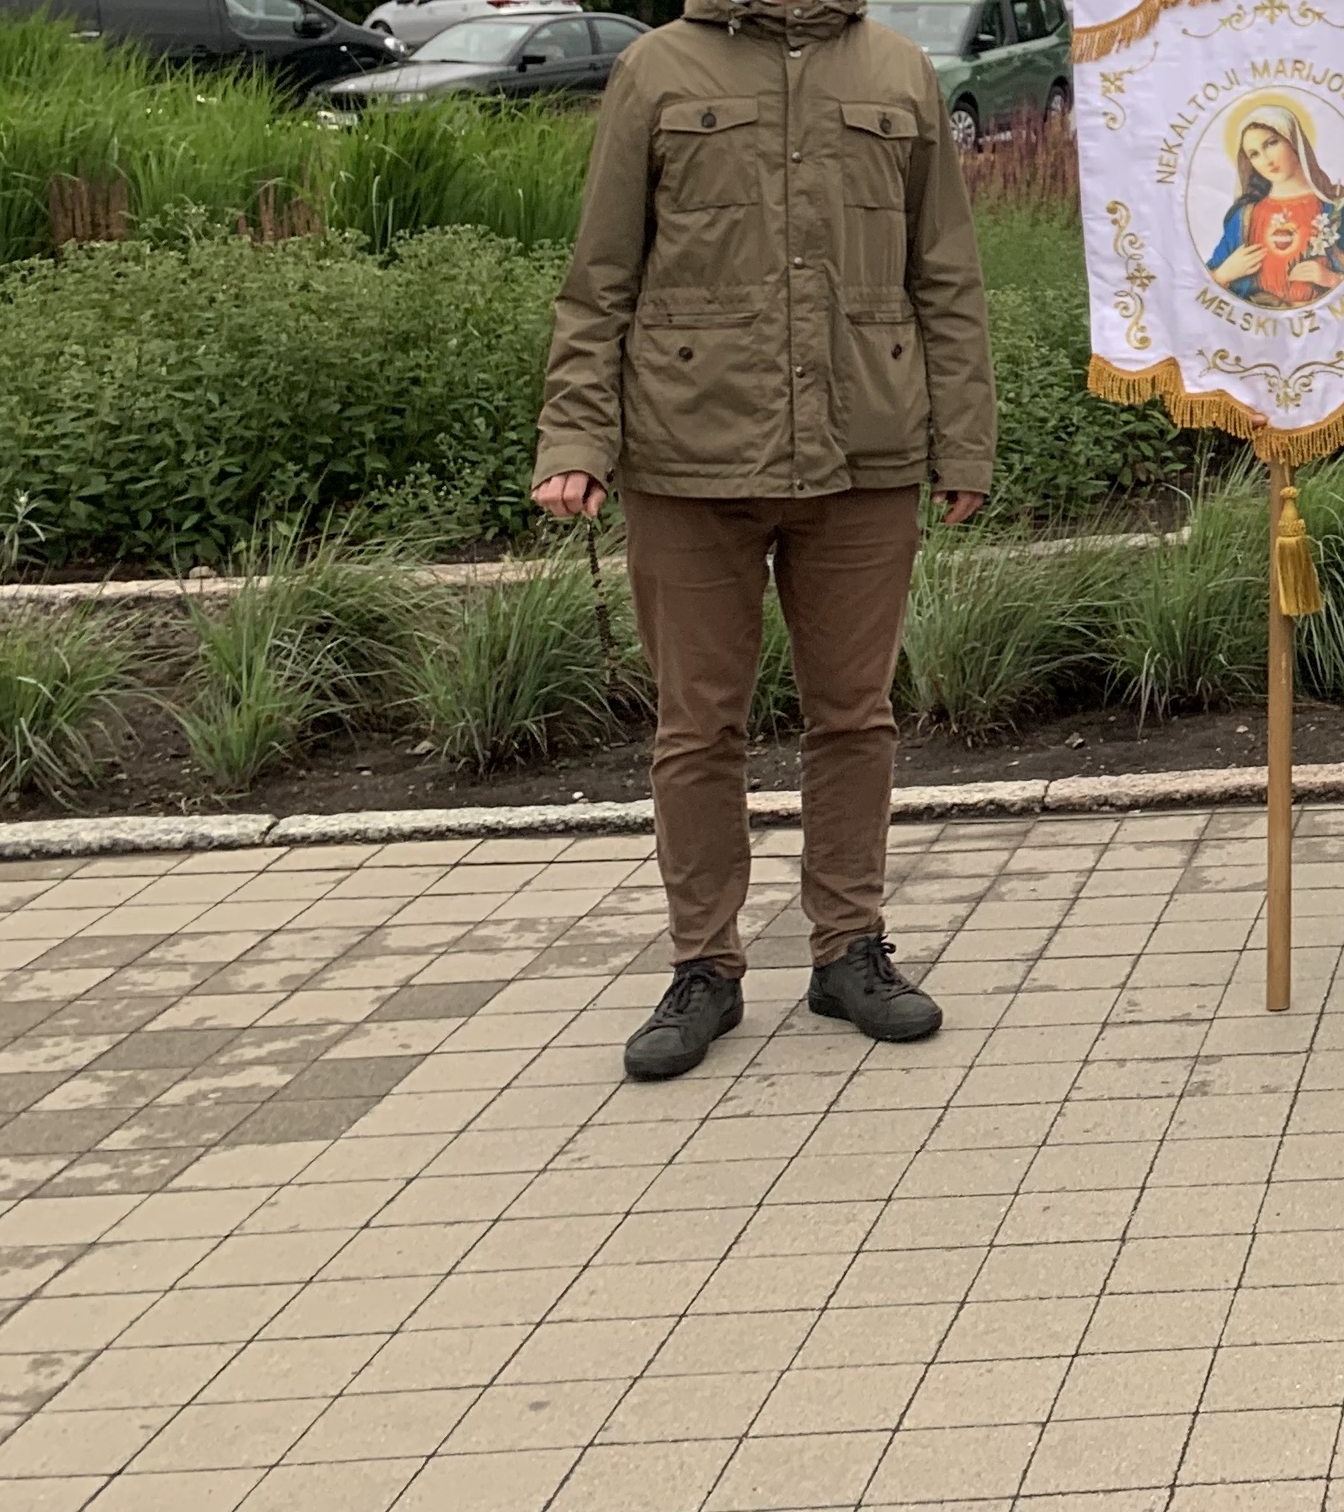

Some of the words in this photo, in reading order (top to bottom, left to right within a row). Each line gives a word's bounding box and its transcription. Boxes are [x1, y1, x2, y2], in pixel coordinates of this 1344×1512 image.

[1156, 68, 1241, 184] NEKALTOJI
[1195, 287, 1278, 337] MELSKI
[1287, 310, 1320, 337] UŽ
